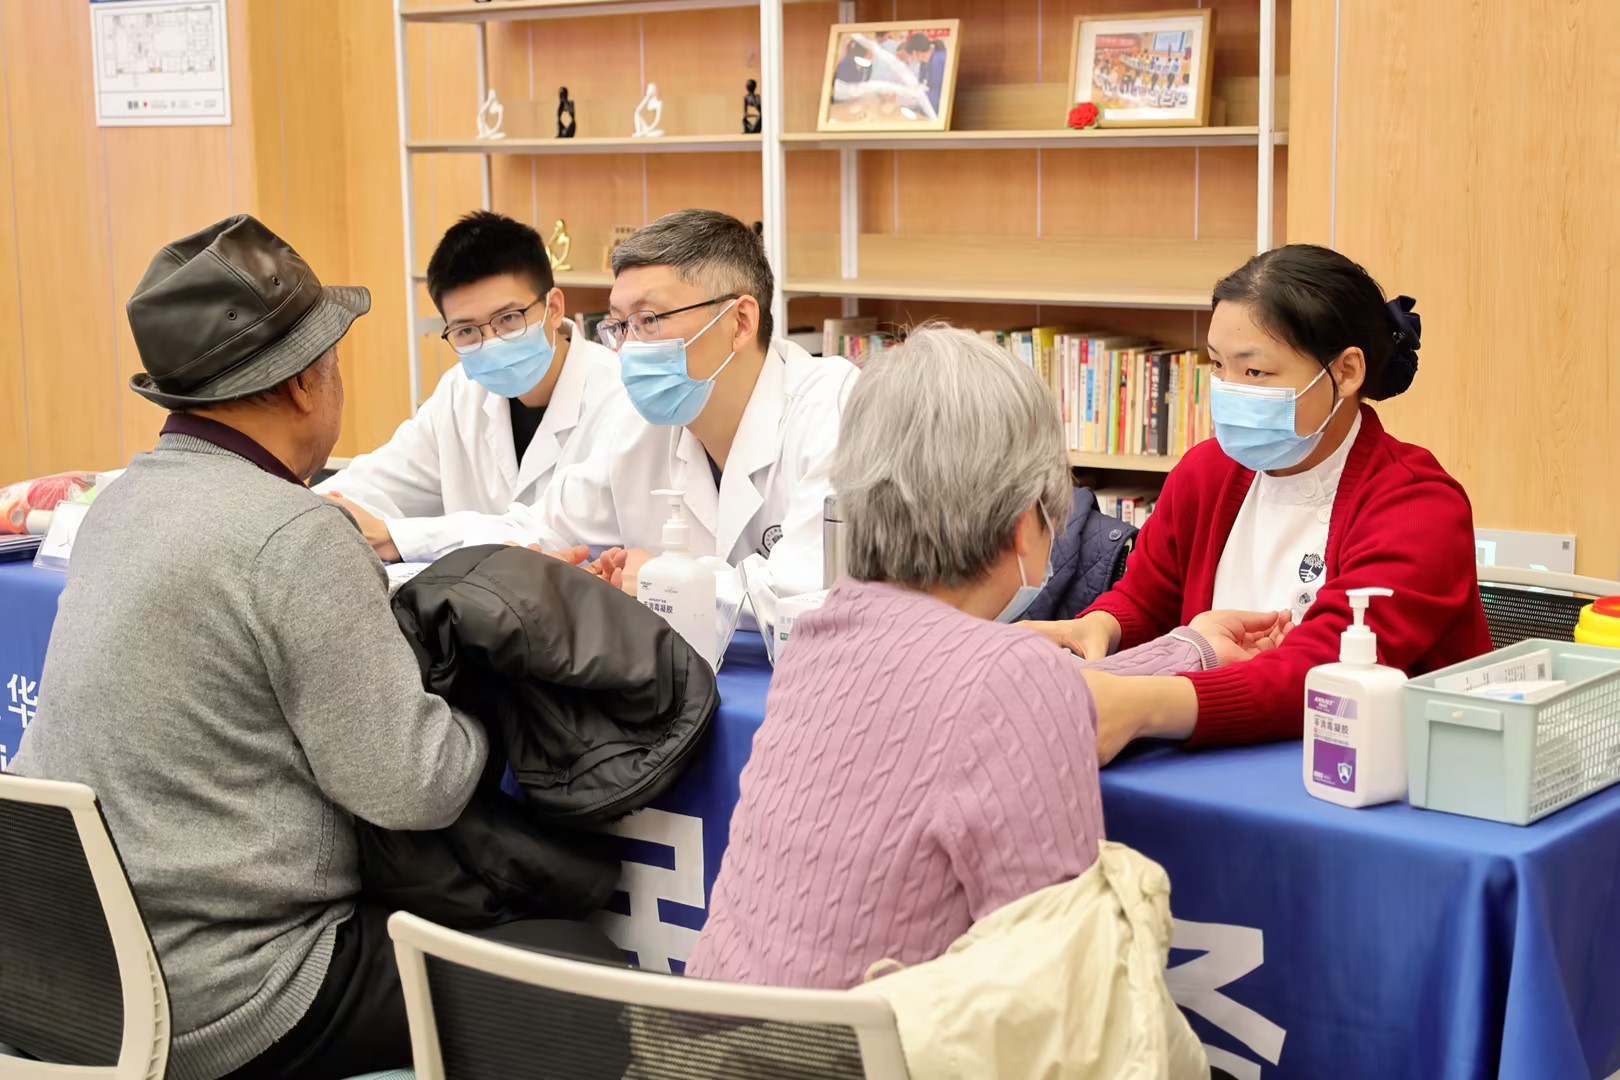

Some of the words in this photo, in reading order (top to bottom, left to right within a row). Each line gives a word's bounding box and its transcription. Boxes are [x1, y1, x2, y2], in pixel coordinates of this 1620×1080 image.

[7, 673, 38, 728] 华
[1314, 718, 1349, 734] 手消毒凝胶
